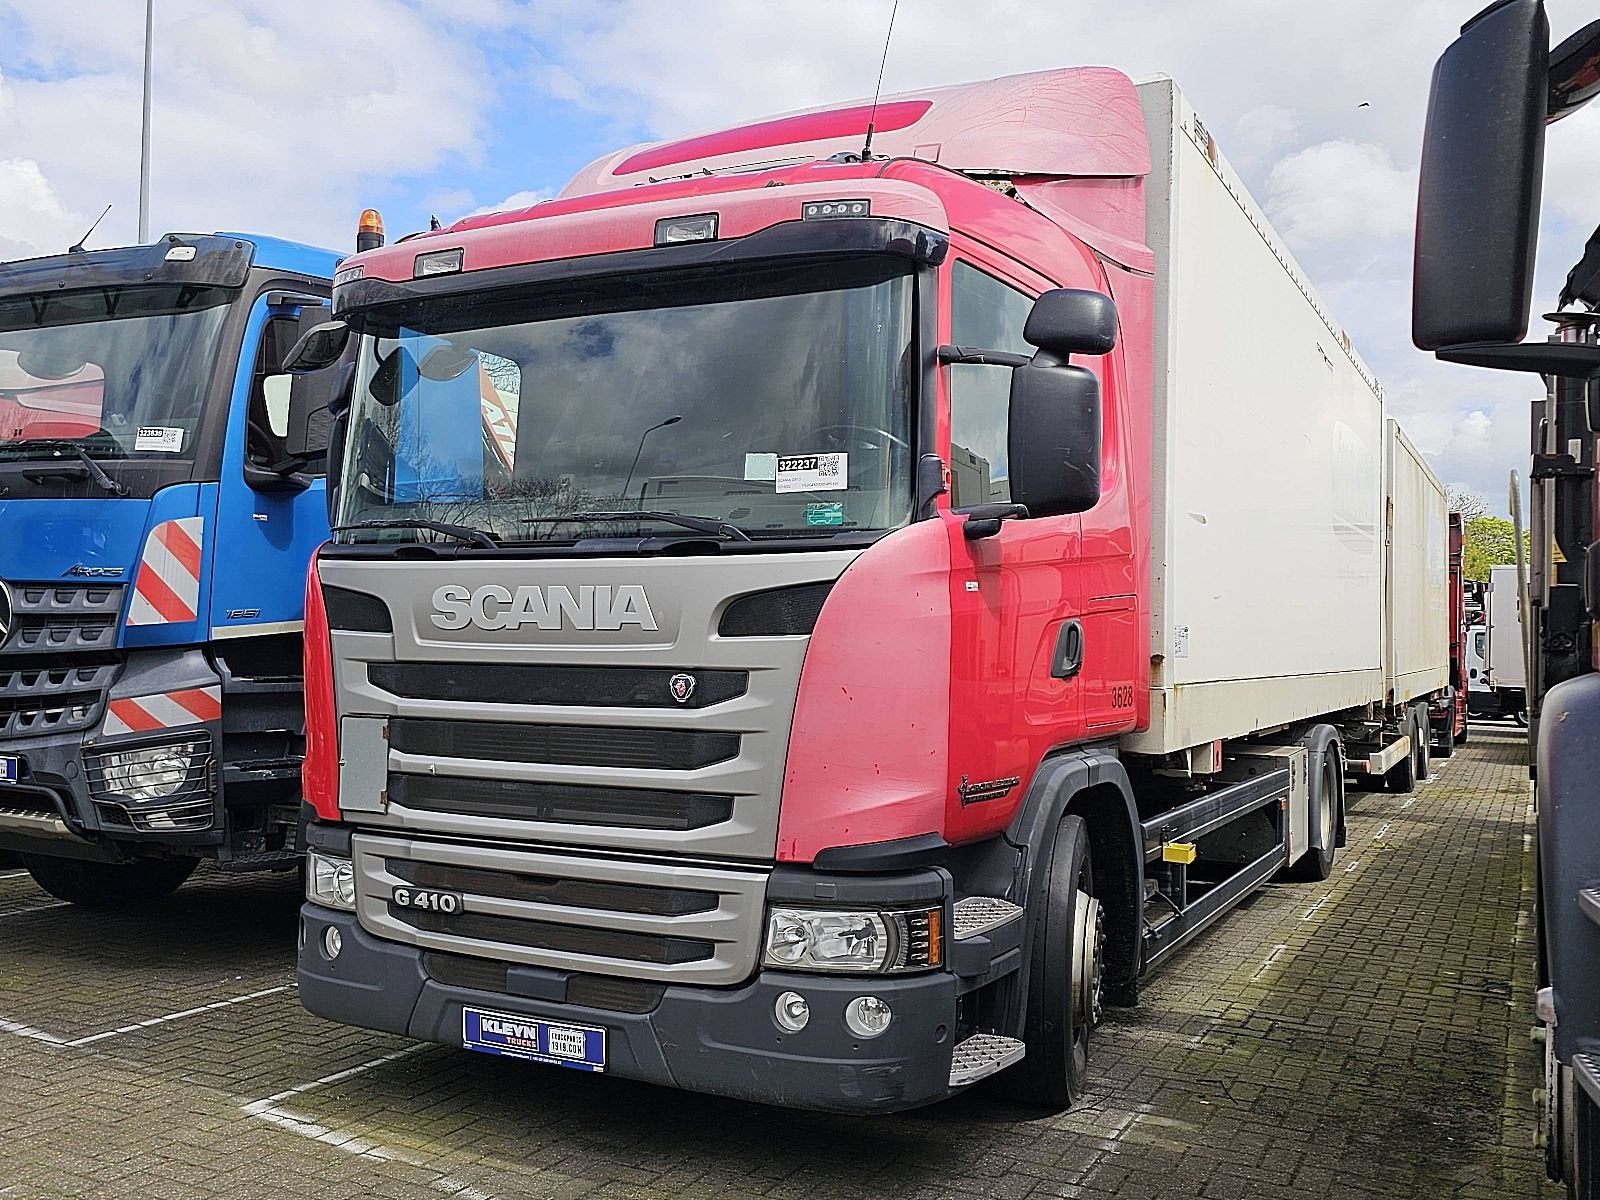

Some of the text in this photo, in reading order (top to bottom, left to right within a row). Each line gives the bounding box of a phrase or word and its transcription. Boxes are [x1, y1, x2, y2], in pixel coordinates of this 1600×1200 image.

[779, 458, 817, 471] 322237
[430, 584, 659, 631] SCANIA
[1111, 686, 1133, 708] 3628
[394, 888, 456, 913] G 410
[481, 1018, 537, 1040] KLEYN
[506, 1036, 537, 1048] TRUCKS
